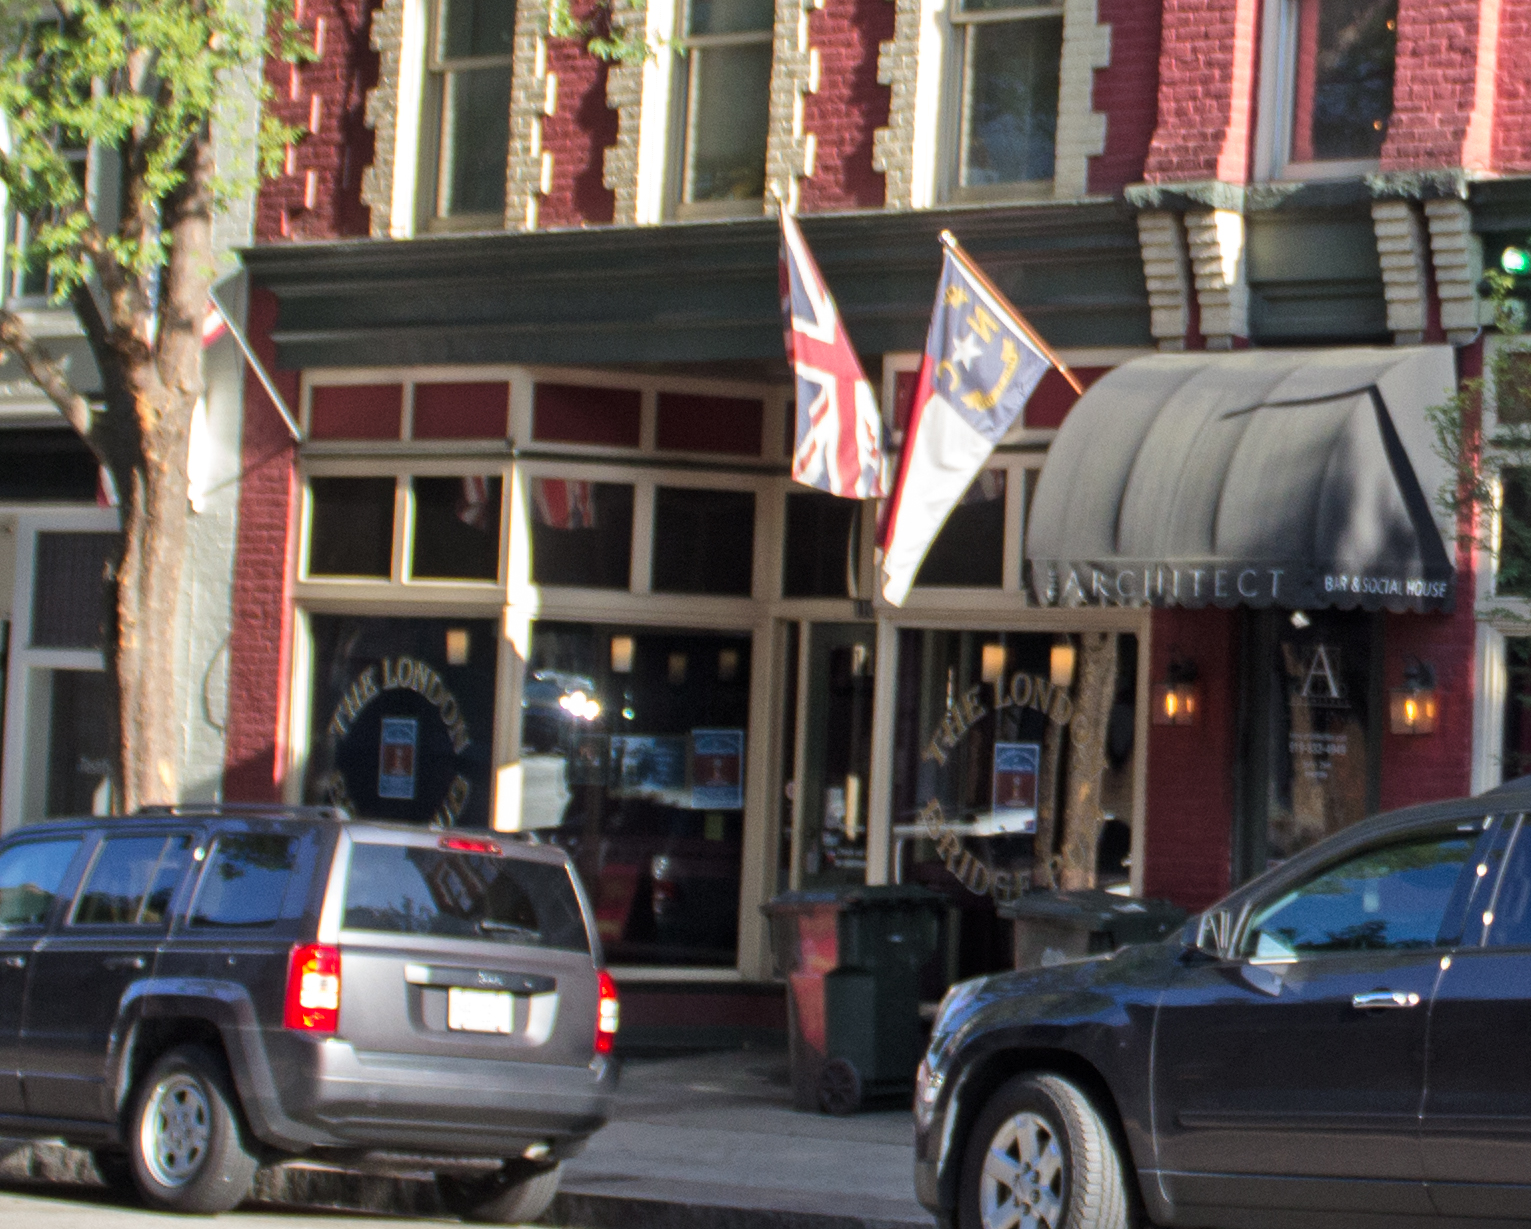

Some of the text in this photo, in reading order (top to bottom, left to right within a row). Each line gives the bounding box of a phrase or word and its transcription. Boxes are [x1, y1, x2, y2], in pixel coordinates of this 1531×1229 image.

[1063, 568, 1285, 600] ARCHITECT
[1324, 575, 1447, 599] BAR & SOCIAL HOUSE
[1300, 644, 1340, 699] A
[327, 656, 471, 755] THE LONDON
[921, 684, 986, 766] THE
